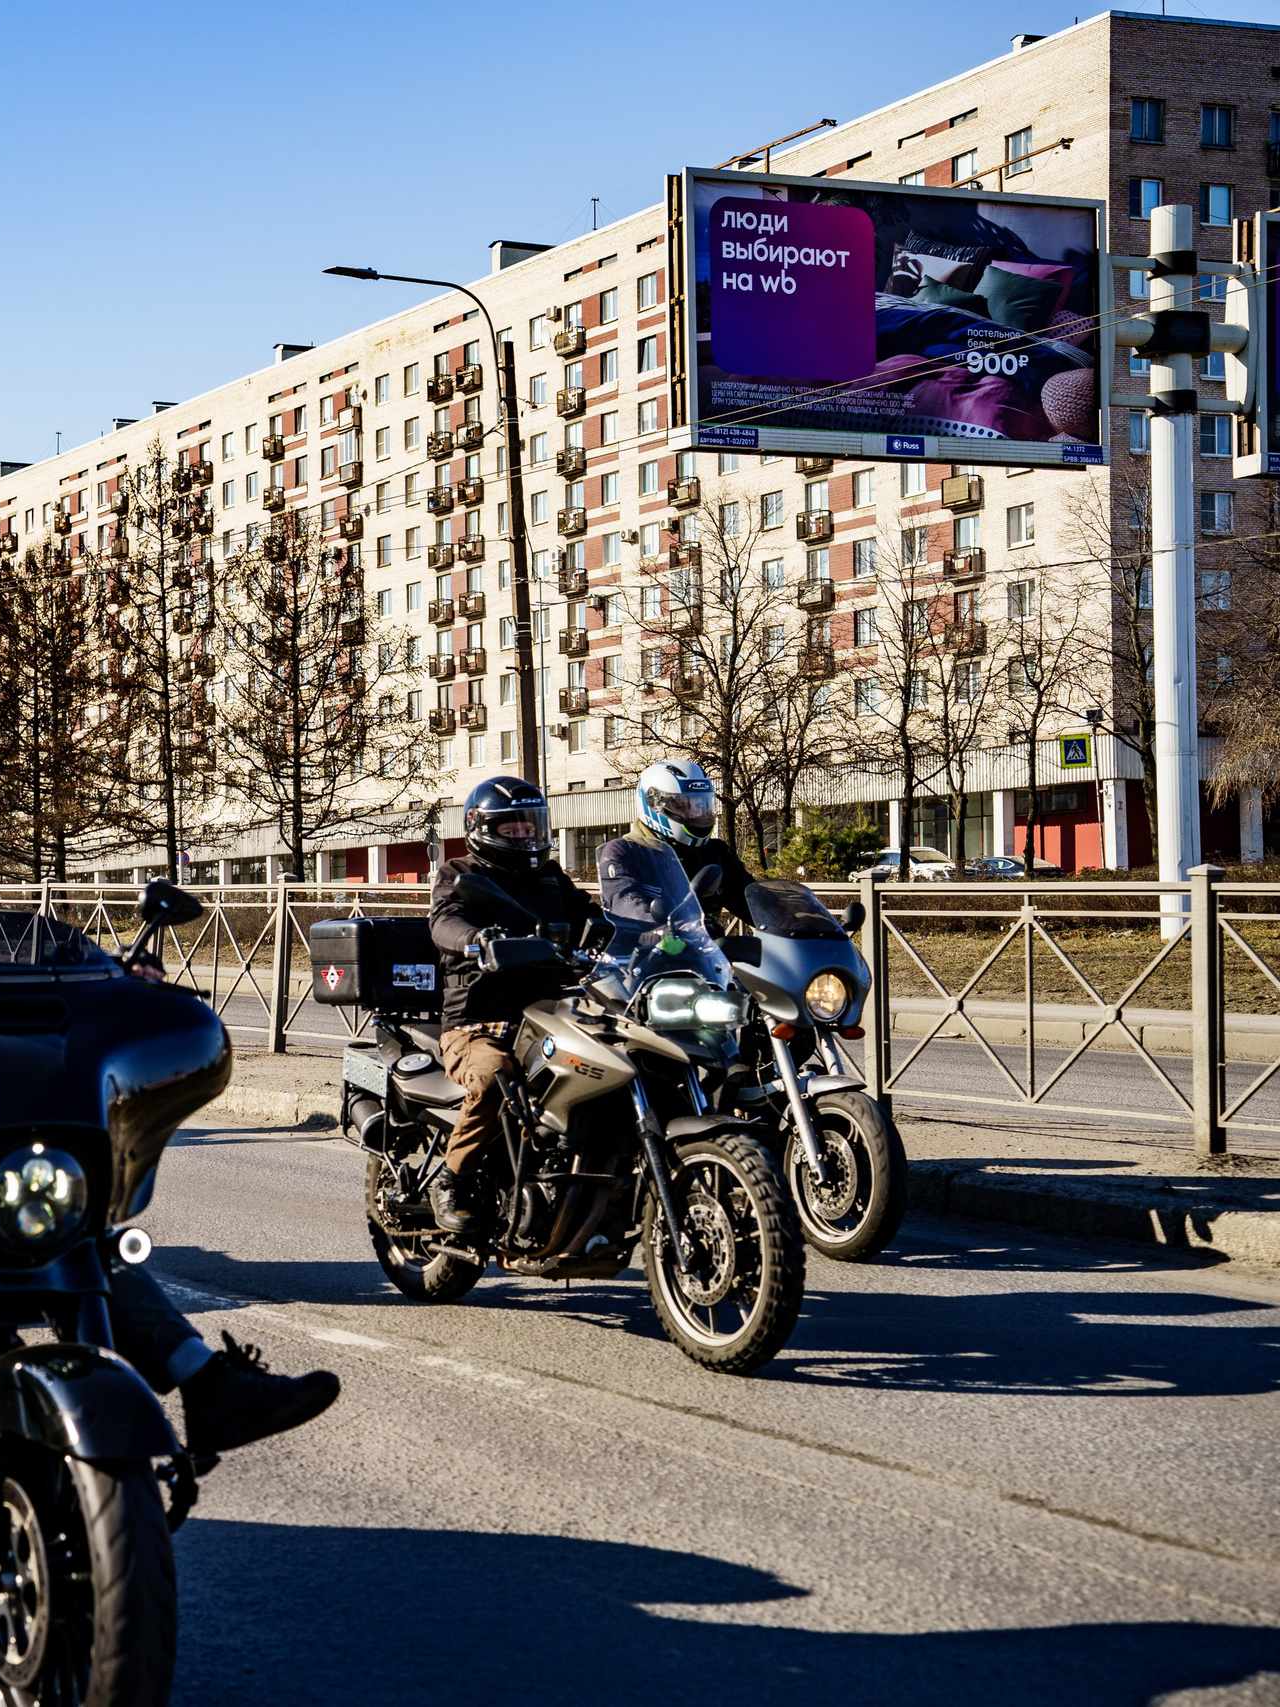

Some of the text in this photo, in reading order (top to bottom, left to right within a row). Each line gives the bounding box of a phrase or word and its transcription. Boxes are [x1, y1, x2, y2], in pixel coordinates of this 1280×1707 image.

[721, 211, 788, 235] люди
[722, 237, 850, 269] выбирают
[723, 269, 797, 294] на wb
[967, 329, 1020, 339] постельное
[967, 338, 995, 349] белье
[711, 389, 725, 397] ЦЕНЫ
[726, 390, 733, 398] НА
[733, 391, 748, 399] САЙТЕ
